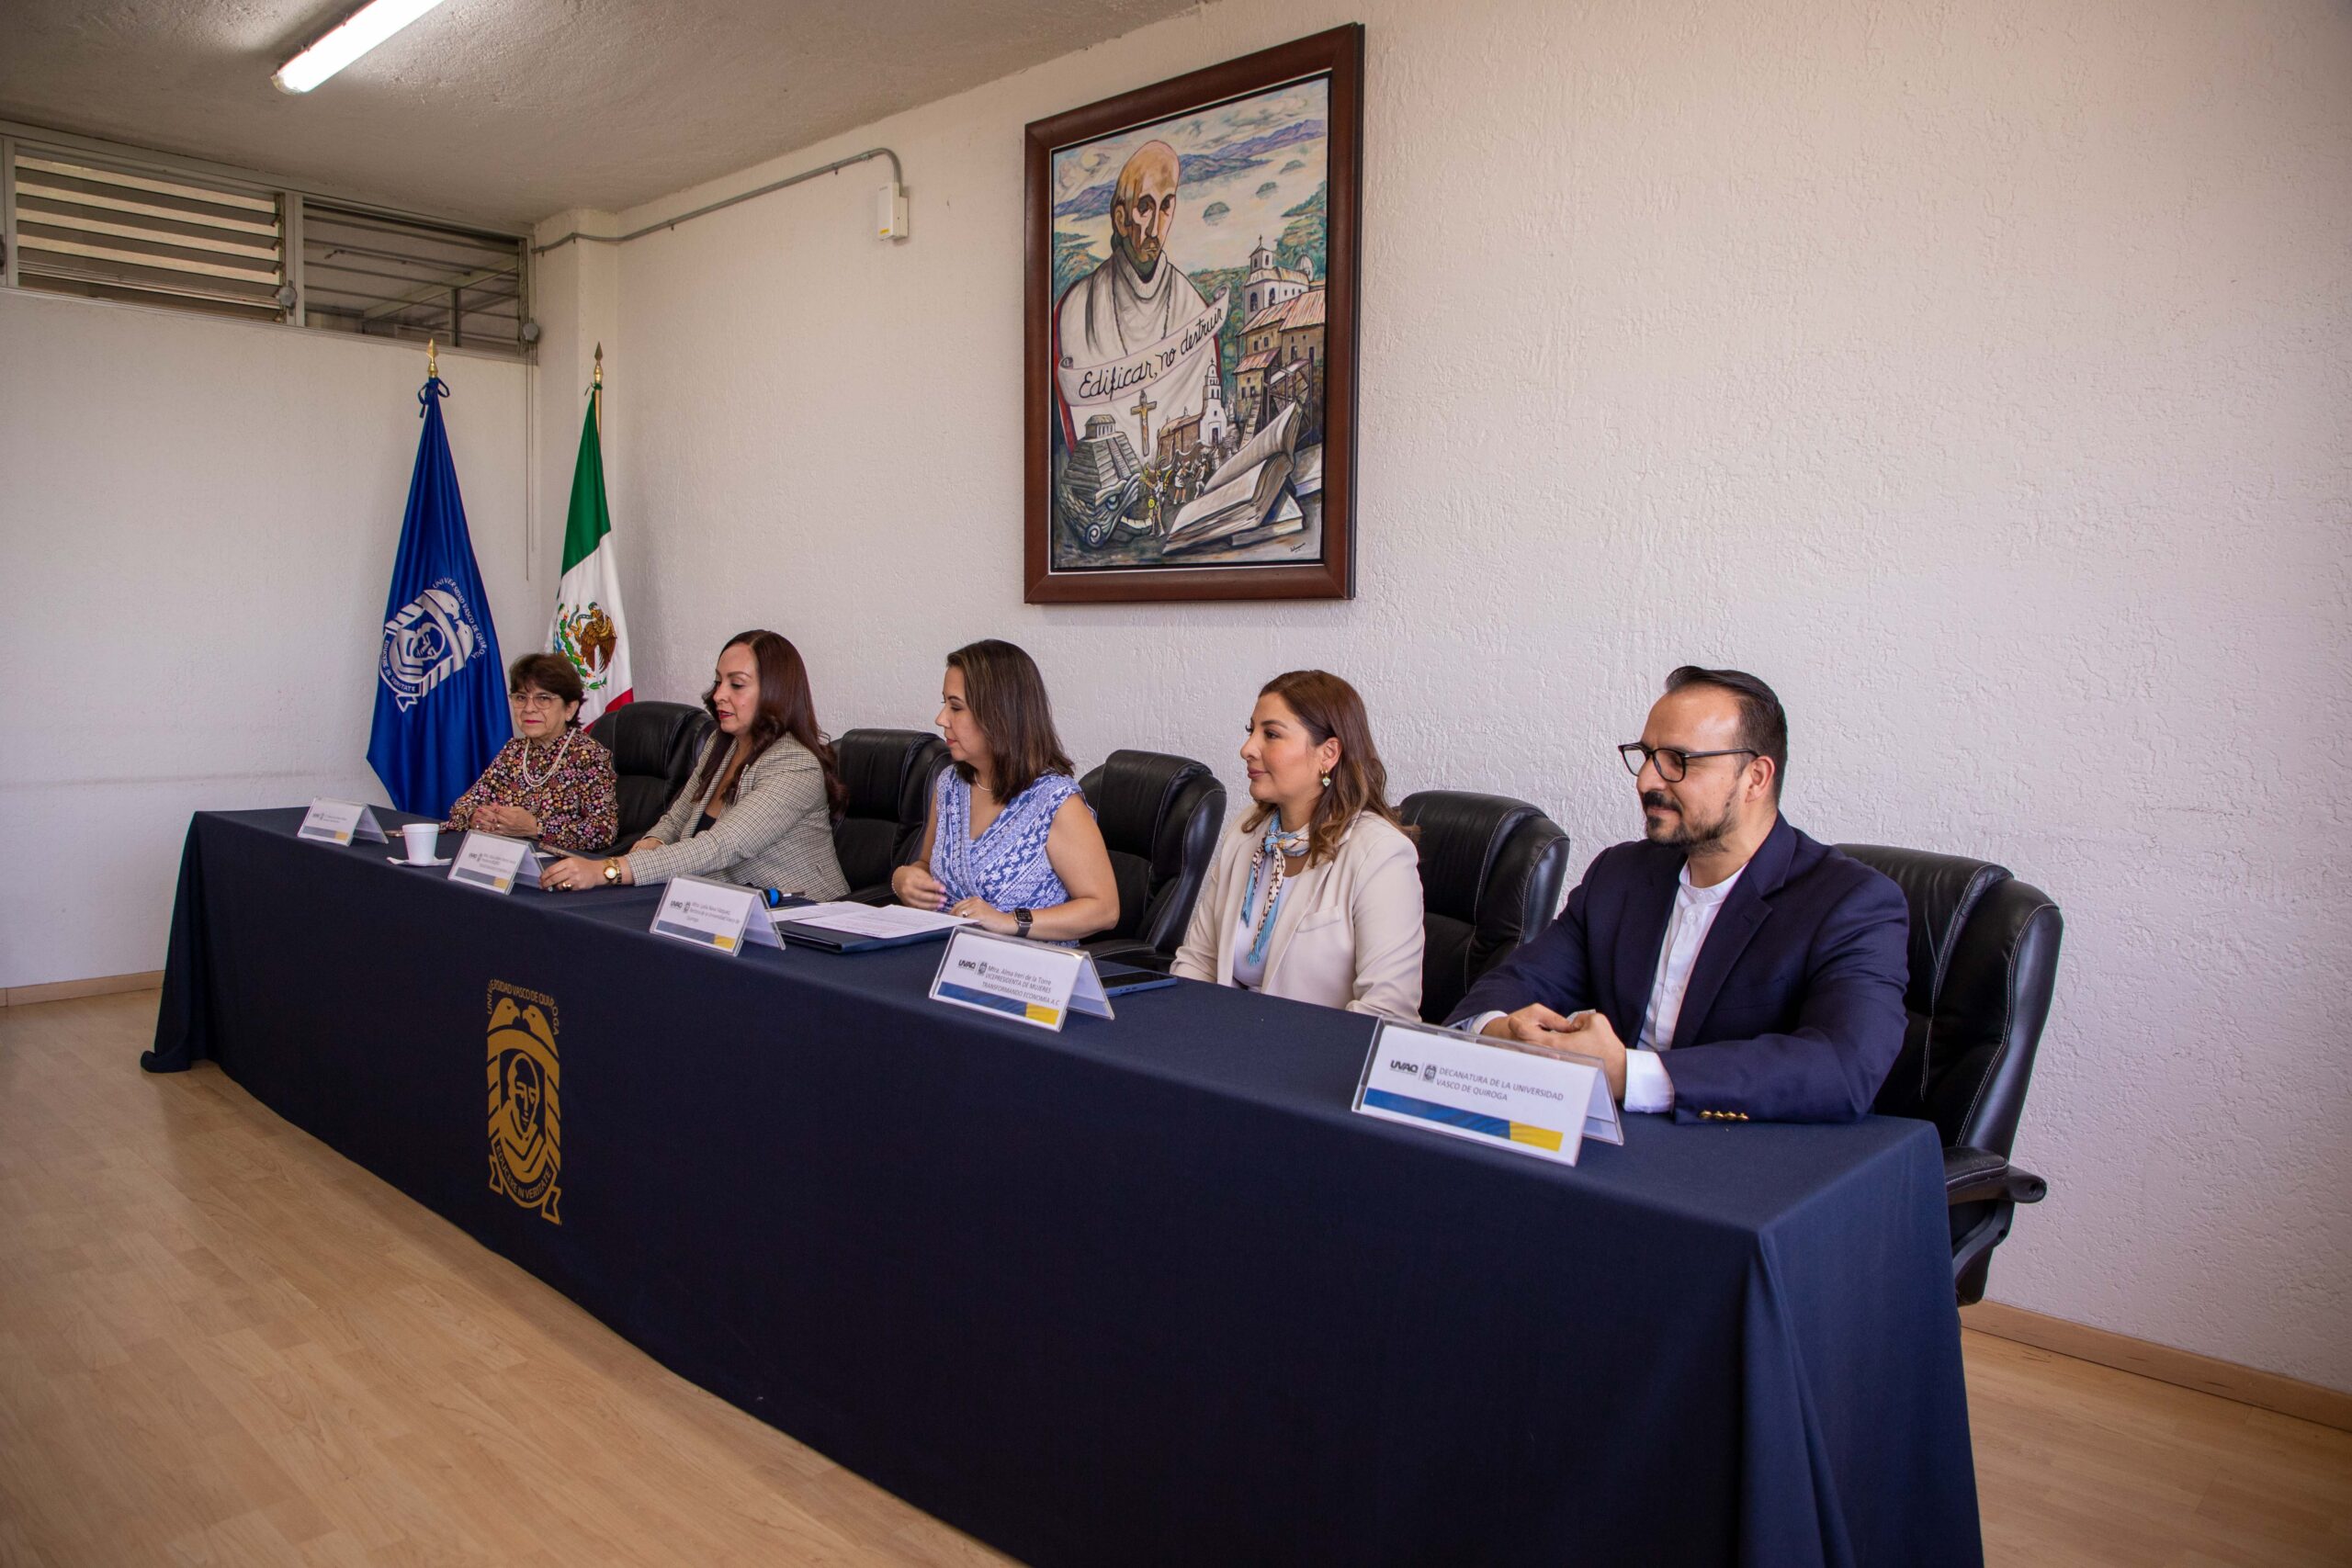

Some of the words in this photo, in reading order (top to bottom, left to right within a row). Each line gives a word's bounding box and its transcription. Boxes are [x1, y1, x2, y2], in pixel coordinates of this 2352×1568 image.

[1156, 348, 1177, 372] no
[1180, 308, 1224, 355] destruir
[432, 577, 465, 604] UNIVERSIDAD
[462, 603, 475, 624] VASCO
[471, 624, 480, 633] DE
[470, 632, 488, 660] QUIROGA
[958, 959, 976, 970] UVAQ
[985, 973, 1022, 987] VICEPRESIDENTA
[1029, 984, 1052, 994] MUJERES
[1001, 968, 1014, 976] Alma
[1038, 976, 1051, 986] Torre
[982, 981, 1023, 997] TRANSFORMANDO
[486, 977, 513, 1015] UNIVERSIDAD
[512, 984, 530, 1000] VASCO
[529, 989, 539, 1003] DE
[538, 993, 560, 1035] QUIROGA
[1390, 1059, 1419, 1074] UVAQ
[1436, 1078, 1461, 1091] VASCO
[1461, 1083, 1472, 1093] DE
[1473, 1087, 1508, 1100] QUIROGA
[1439, 1067, 1488, 1085] DECANATURA
[1488, 1077, 1500, 1088] DE
[1501, 1080, 1511, 1089] LA
[1512, 1083, 1565, 1101] UNIVERSIDAD
[496, 1145, 517, 1193] EDUCERE
[517, 1187, 525, 1199] IN
[525, 1168, 551, 1199] VERITATE
